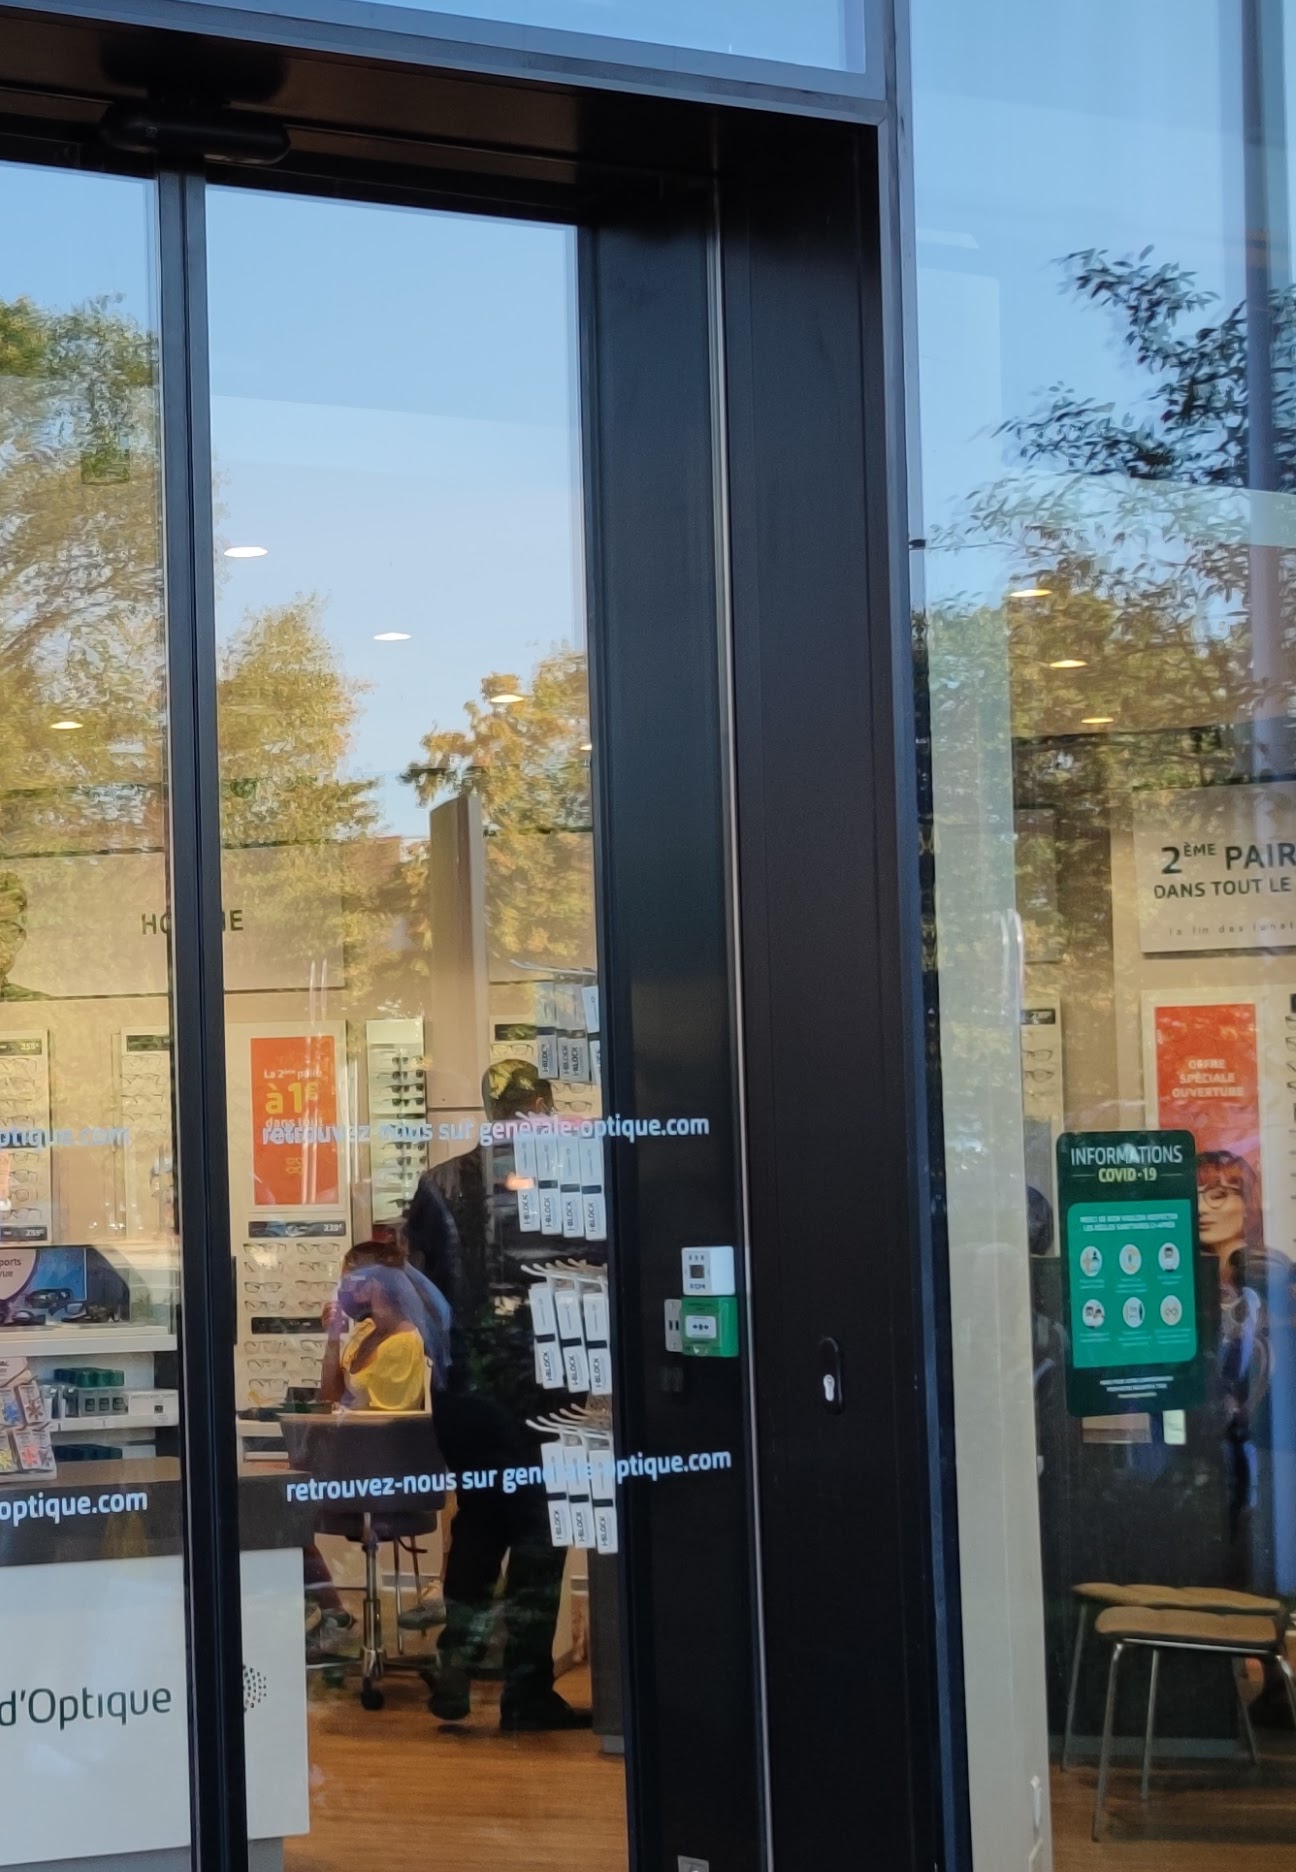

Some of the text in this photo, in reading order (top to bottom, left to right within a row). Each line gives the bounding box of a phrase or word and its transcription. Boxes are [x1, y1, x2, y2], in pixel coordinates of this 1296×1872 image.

[1154, 876, 1292, 899] DANS TOUT LE
[1171, 1086, 1246, 1098] OUVERTURE
[438, 1120, 475, 1141] sur
[479, 1113, 710, 1147] generale-optique.com
[1070, 1145, 1184, 1166] INFORMATIONS
[286, 1471, 457, 1502] retrouvez-nous
[461, 1468, 499, 1490] sur
